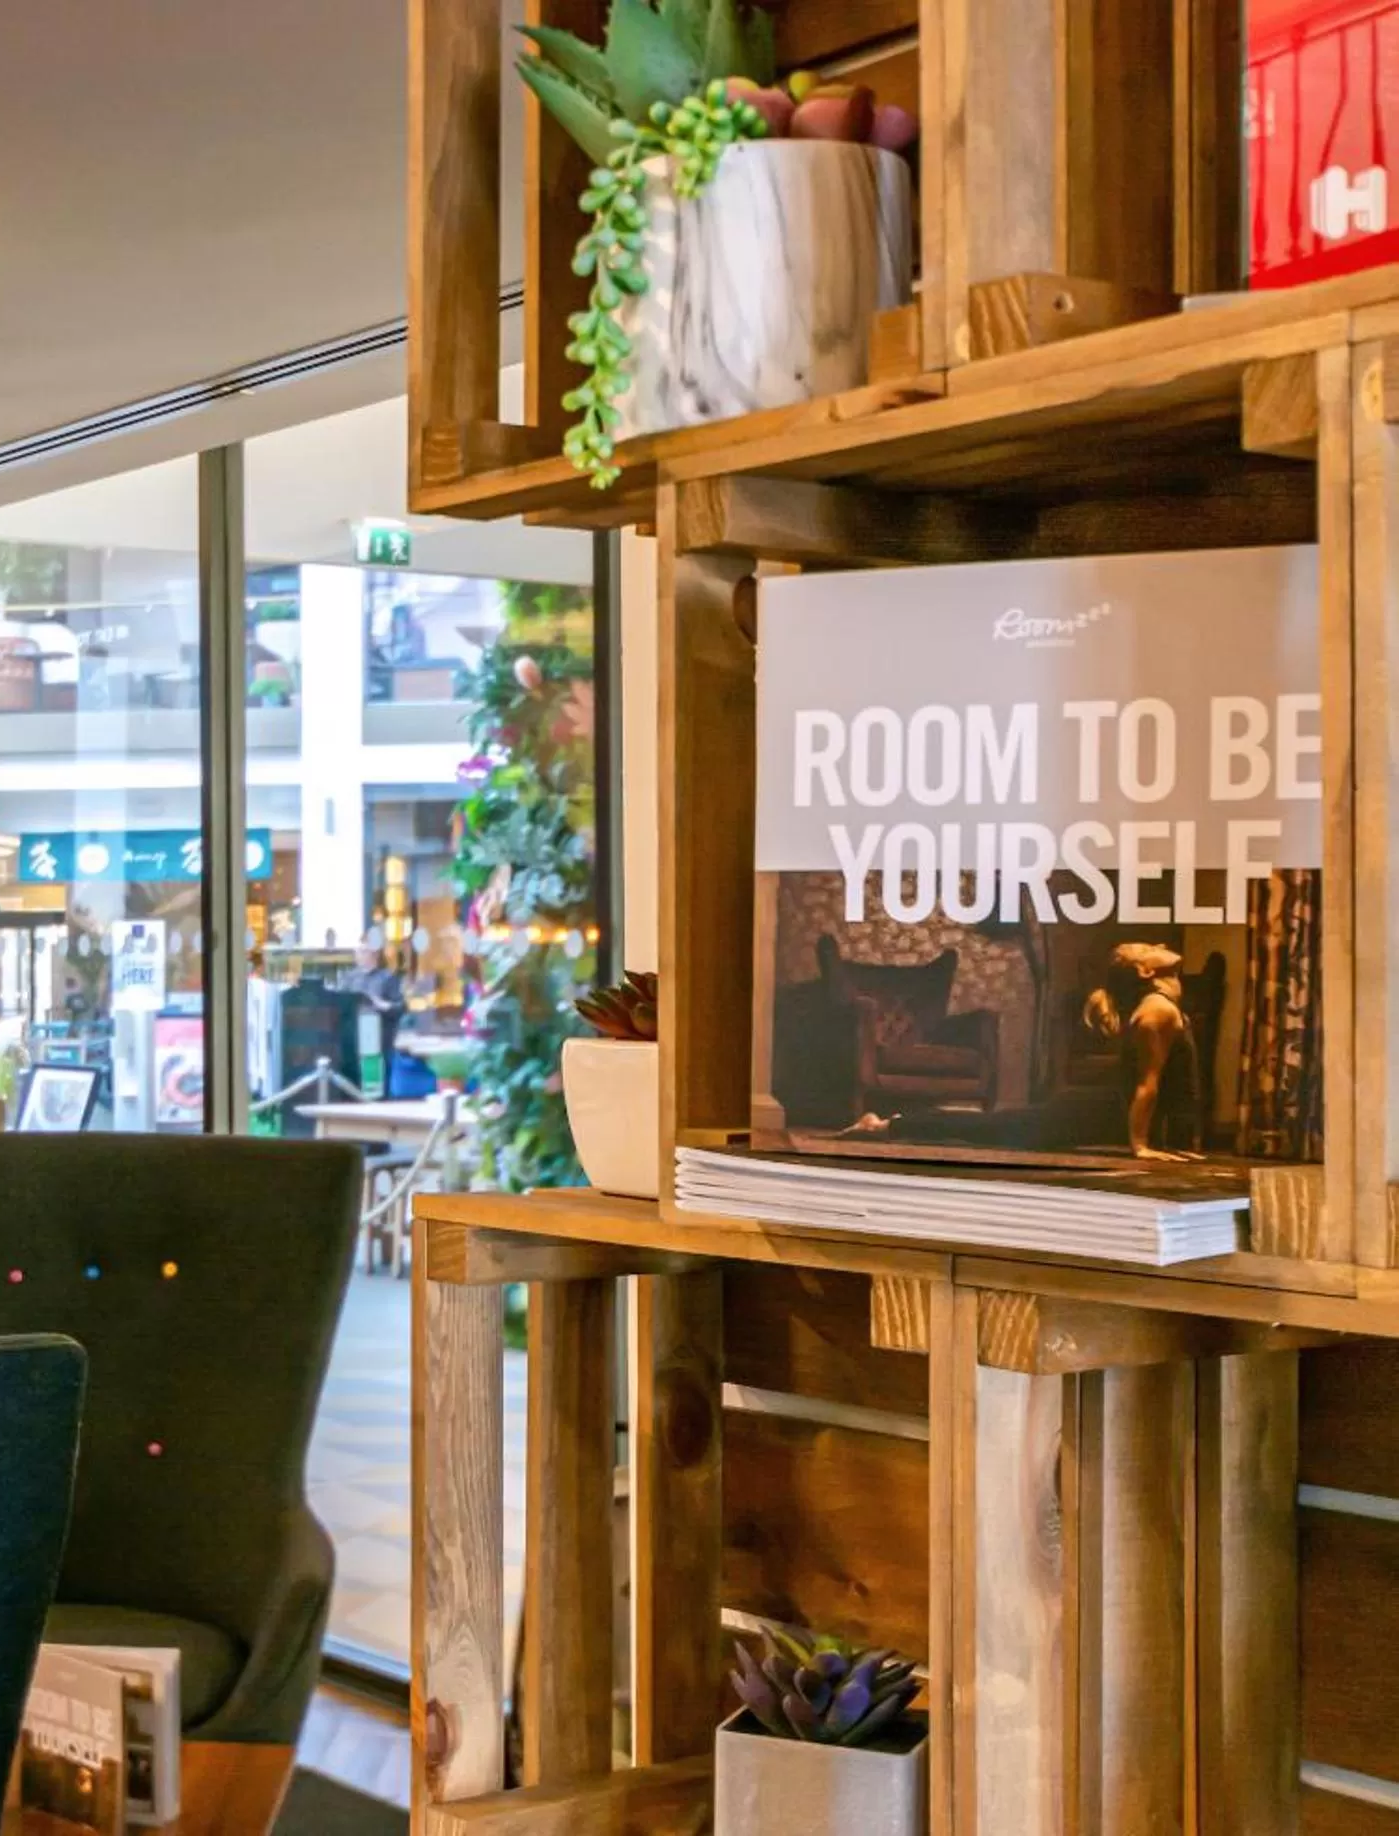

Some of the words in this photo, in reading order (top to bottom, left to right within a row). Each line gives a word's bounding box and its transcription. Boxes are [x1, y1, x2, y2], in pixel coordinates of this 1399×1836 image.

[794, 702, 1039, 807] ROOM
[1063, 697, 1176, 803] TO
[1209, 693, 1322, 801] BE
[827, 820, 1282, 925] YOURSELF
